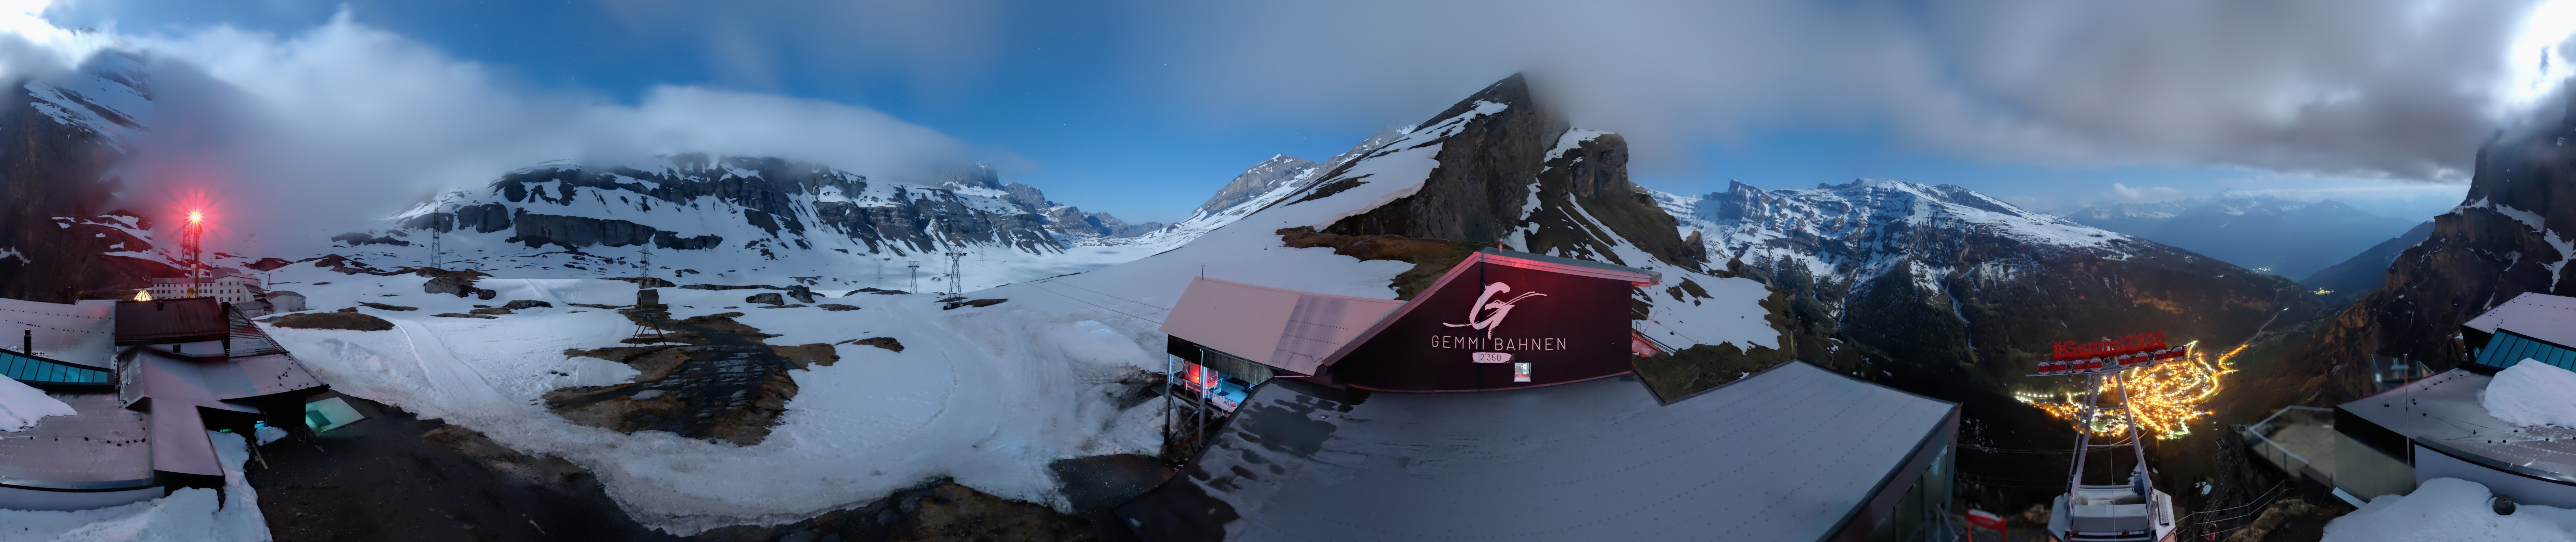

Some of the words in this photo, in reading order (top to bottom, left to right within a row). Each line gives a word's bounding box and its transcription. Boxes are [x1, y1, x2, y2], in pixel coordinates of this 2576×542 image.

[1432, 335, 1484, 350] GEMMI
[1495, 338, 1566, 351] BAHNEN
[2053, 331, 2165, 355] #Gemmi2350
